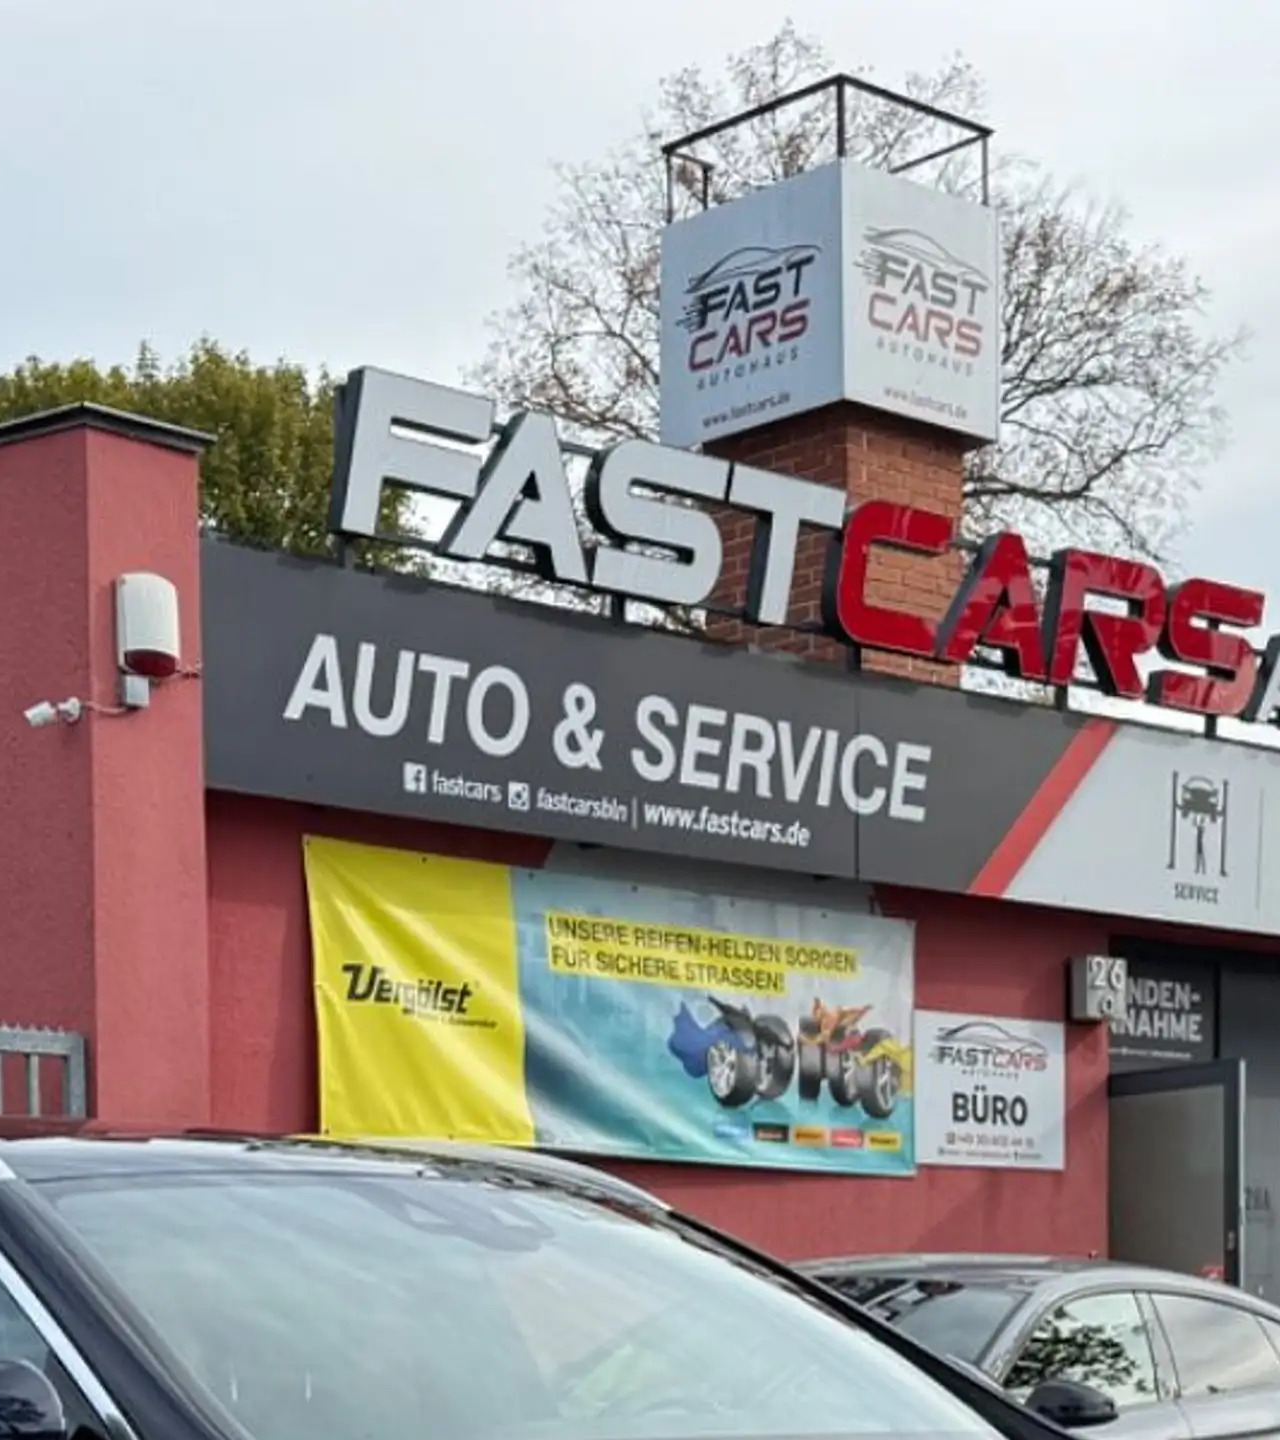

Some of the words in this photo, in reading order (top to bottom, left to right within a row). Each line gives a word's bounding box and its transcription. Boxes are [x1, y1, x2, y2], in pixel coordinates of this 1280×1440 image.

[682, 254, 815, 332] FAST
[858, 249, 988, 316] FAST
[688, 298, 811, 373] CARS
[867, 290, 983, 359] CARS
[696, 347, 800, 391] AUTOHAUS
[875, 335, 974, 378] AUTOHAUS
[283, 632, 530, 758] AUTO
[552, 682, 604, 771] &
[631, 694, 932, 822] SERVICE
[432, 768, 502, 802] fastcars
[643, 801, 811, 848] www.fastcars.de
[549, 915, 632, 946] UNSERE
[635, 928, 781, 962] REIFEN-HELDEN
[784, 945, 857, 973] SORGEN
[551, 944, 592, 969] FÜR
[596, 950, 681, 982] SICHERE
[685, 960, 786, 992] STRASSEN!
[1125, 976, 1201, 1010] NDEN-
[951, 1084, 1028, 1127] BÜRO
